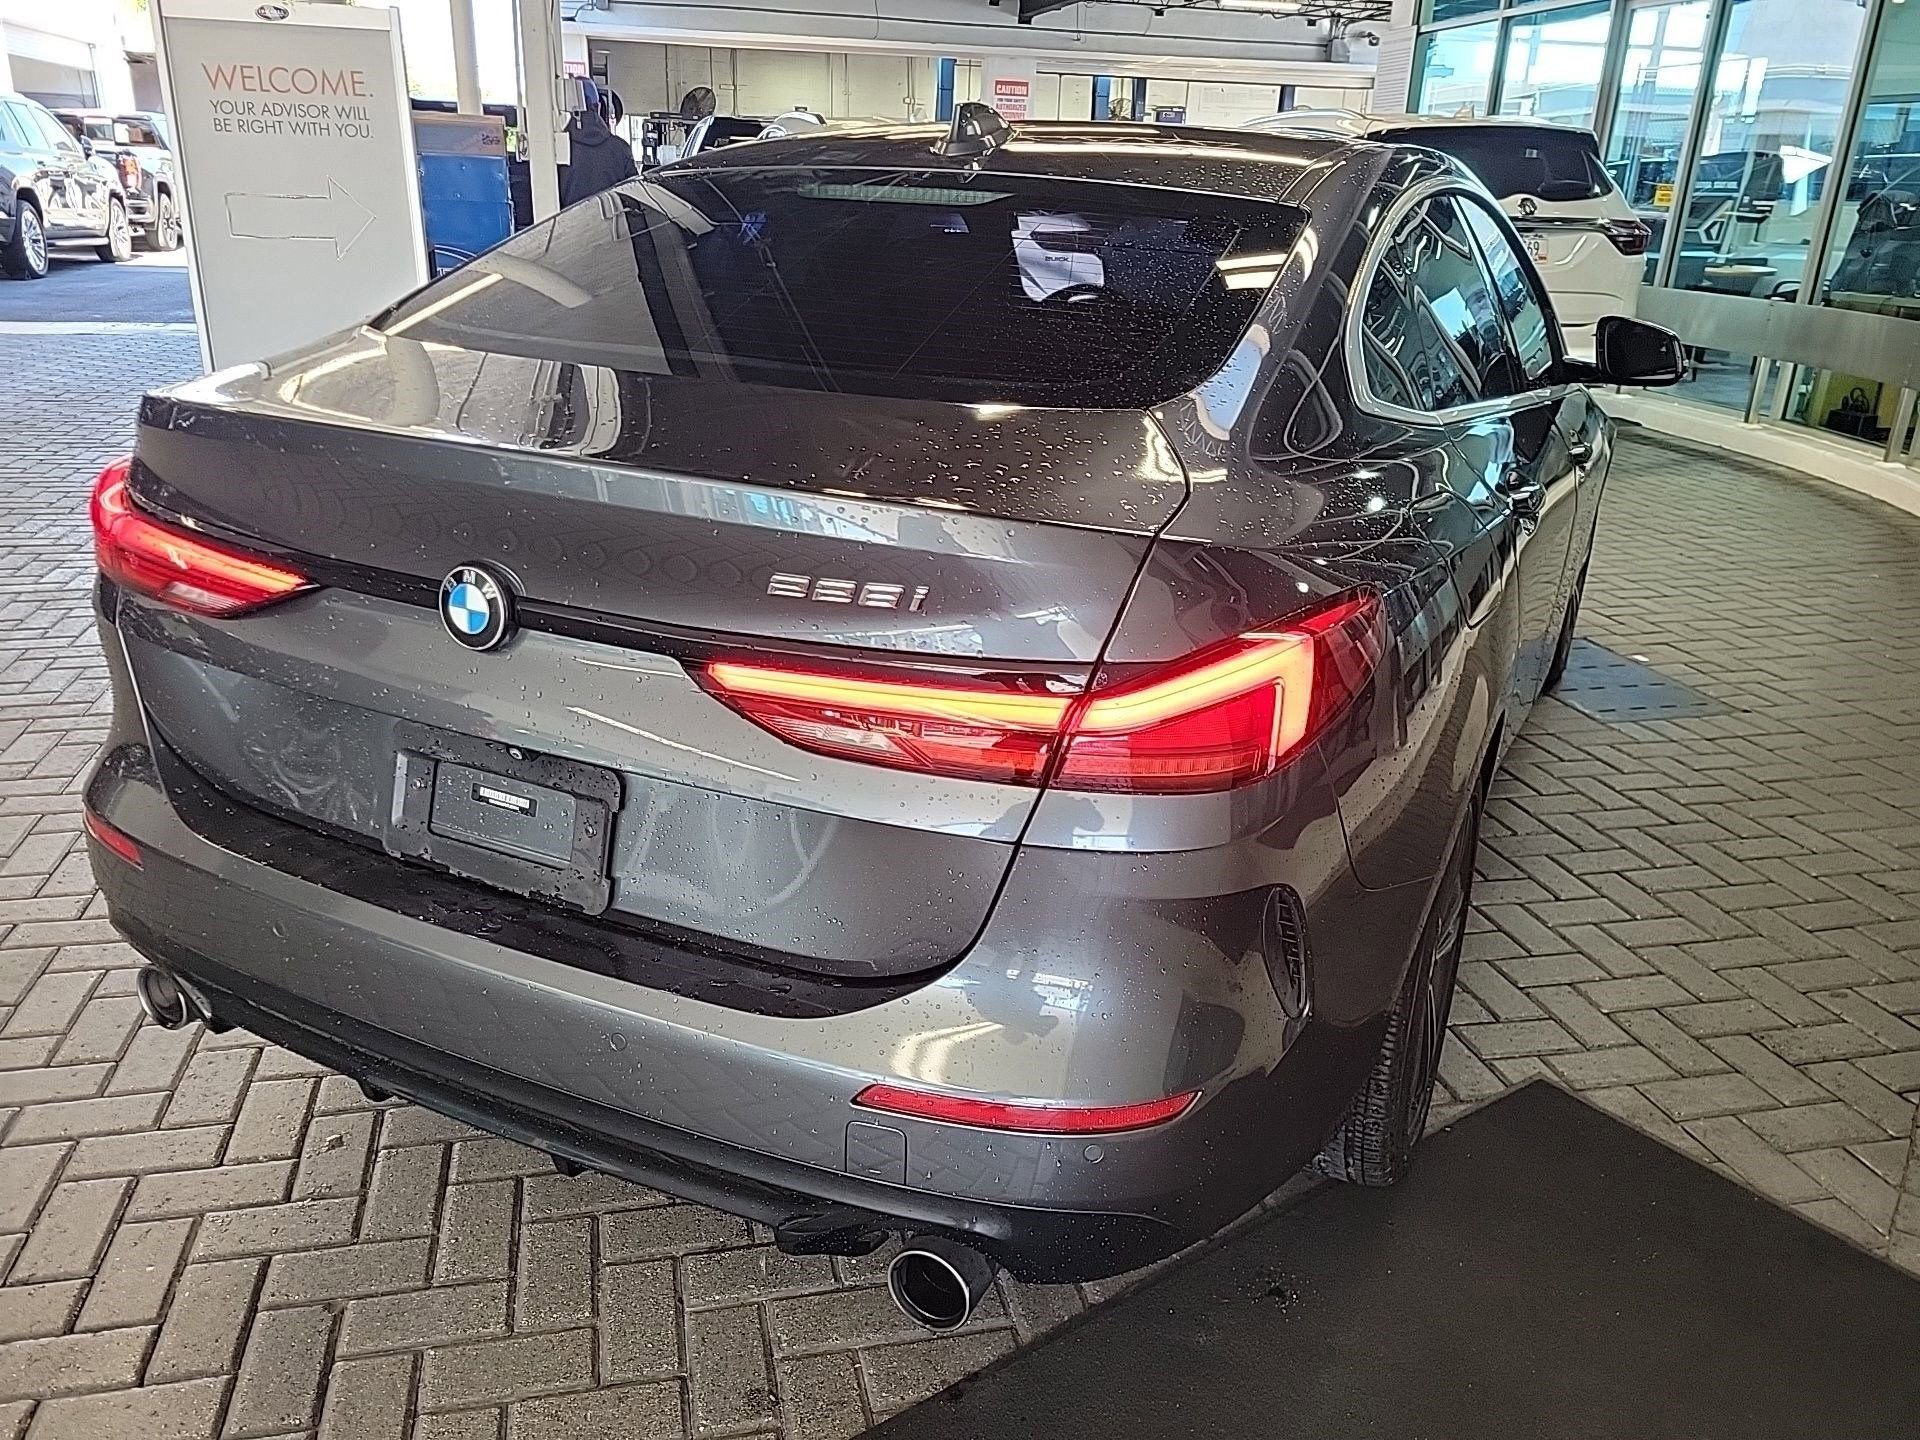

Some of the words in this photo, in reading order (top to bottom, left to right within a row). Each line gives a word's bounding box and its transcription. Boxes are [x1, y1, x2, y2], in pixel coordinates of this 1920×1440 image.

[201, 63, 374, 98] WELCOME.
[996, 84, 1028, 96] CAUTION
[209, 100, 256, 116] YOUR
[260, 102, 331, 119] ADVISOR
[334, 105, 371, 121] WILL
[213, 117, 233, 132] BE
[237, 118, 284, 135] RIGHT
[288, 120, 330, 137] WITH
[335, 123, 374, 139] YOU.
[1044, 255, 1069, 263] BUICK
[445, 569, 497, 600] BMW
